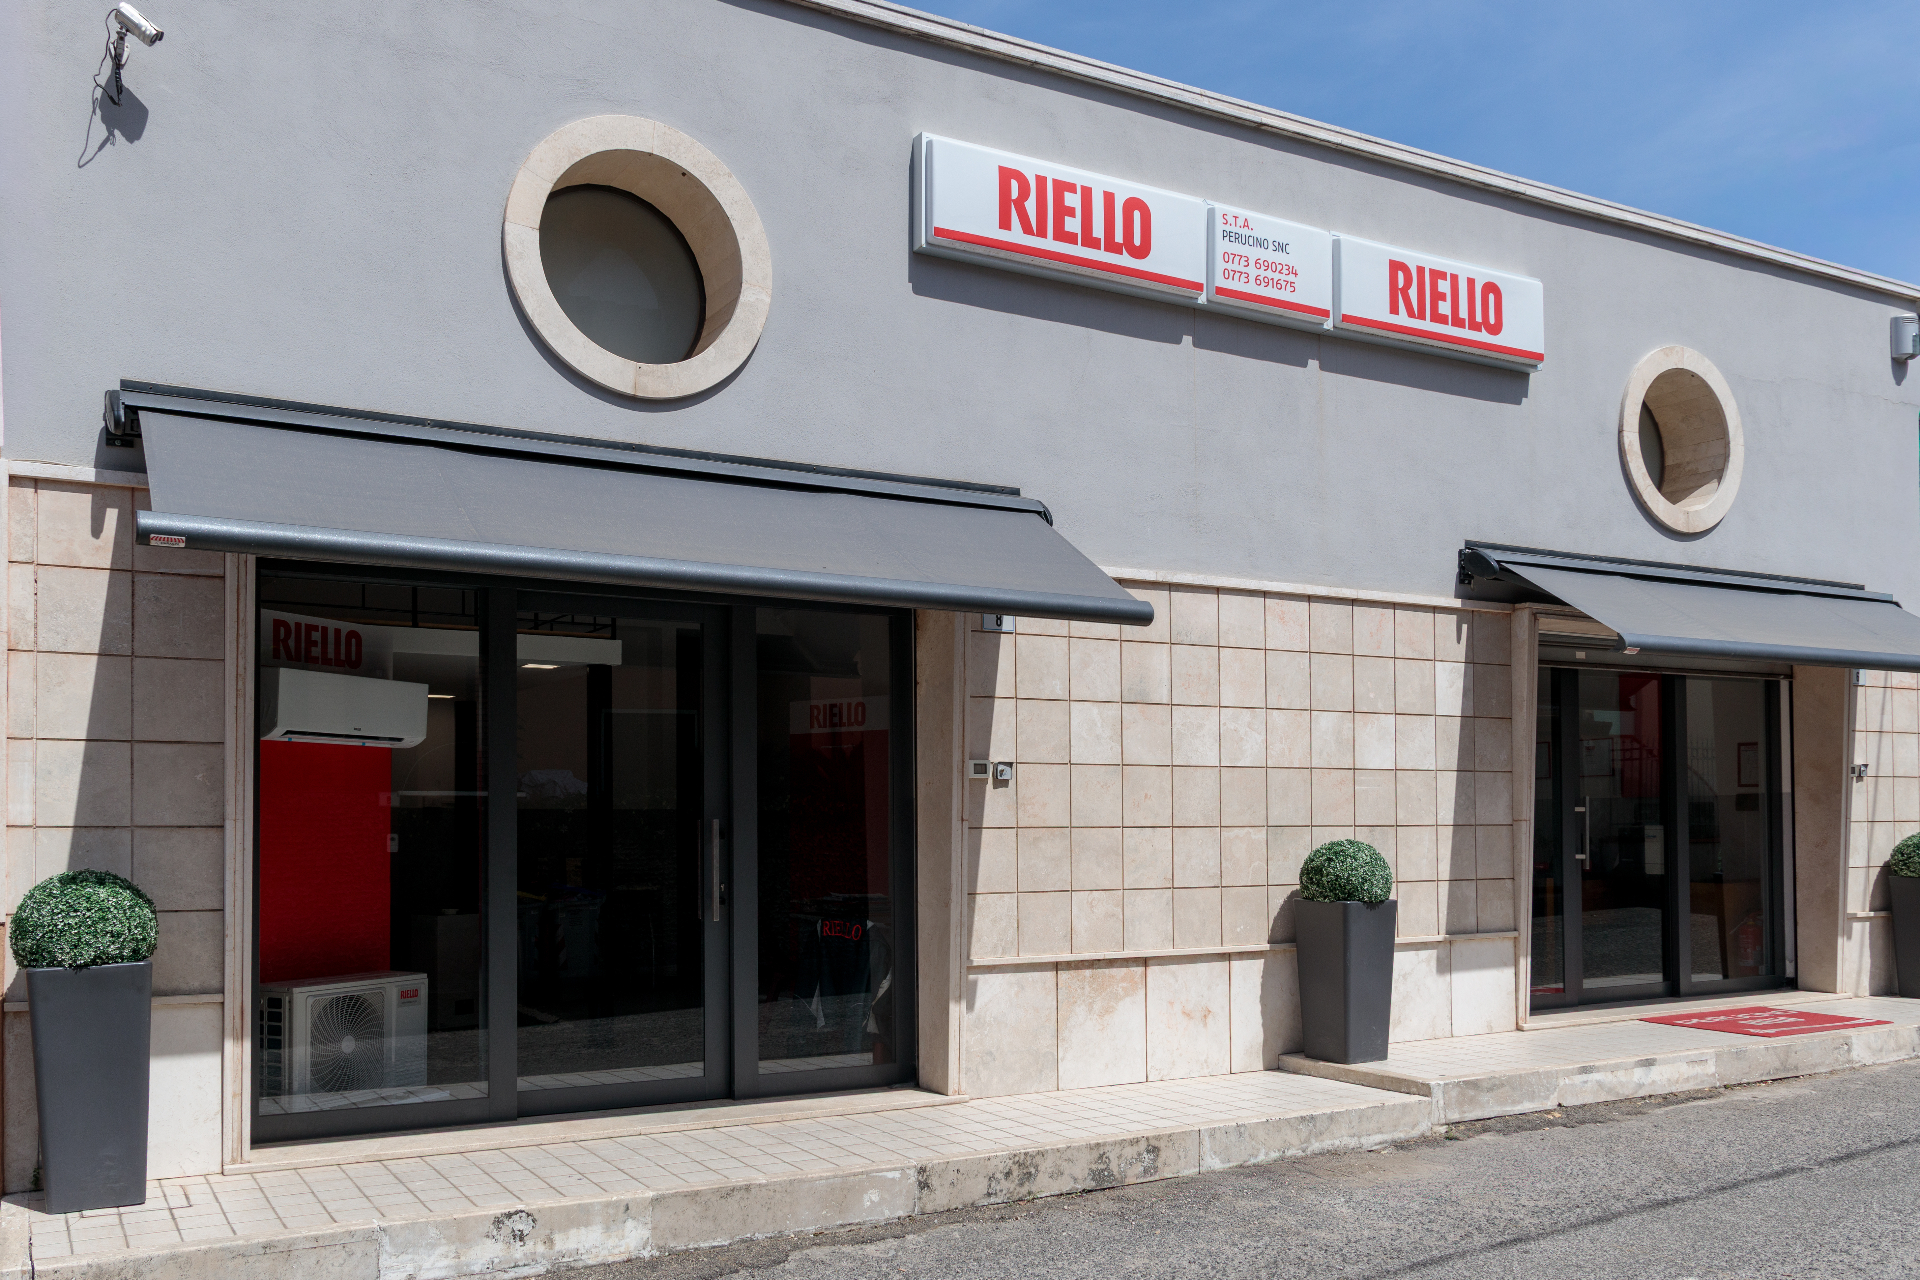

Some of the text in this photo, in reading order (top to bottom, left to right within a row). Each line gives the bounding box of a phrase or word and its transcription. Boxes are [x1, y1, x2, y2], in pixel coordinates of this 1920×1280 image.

[998, 165, 1152, 260] RIELLO
[1222, 213, 1254, 231] S.T.A.
[1222, 229, 1290, 255] PERUCINO SNC
[1222, 251, 1299, 278] 0773 690234
[1222, 268, 1296, 293] 0773 691675
[1388, 259, 1503, 336] RIELLO
[272, 618, 363, 670] RIELLO
[809, 701, 866, 729] RIELLO
[823, 920, 862, 941] RIELLO
[400, 988, 419, 1000] RIELLO
